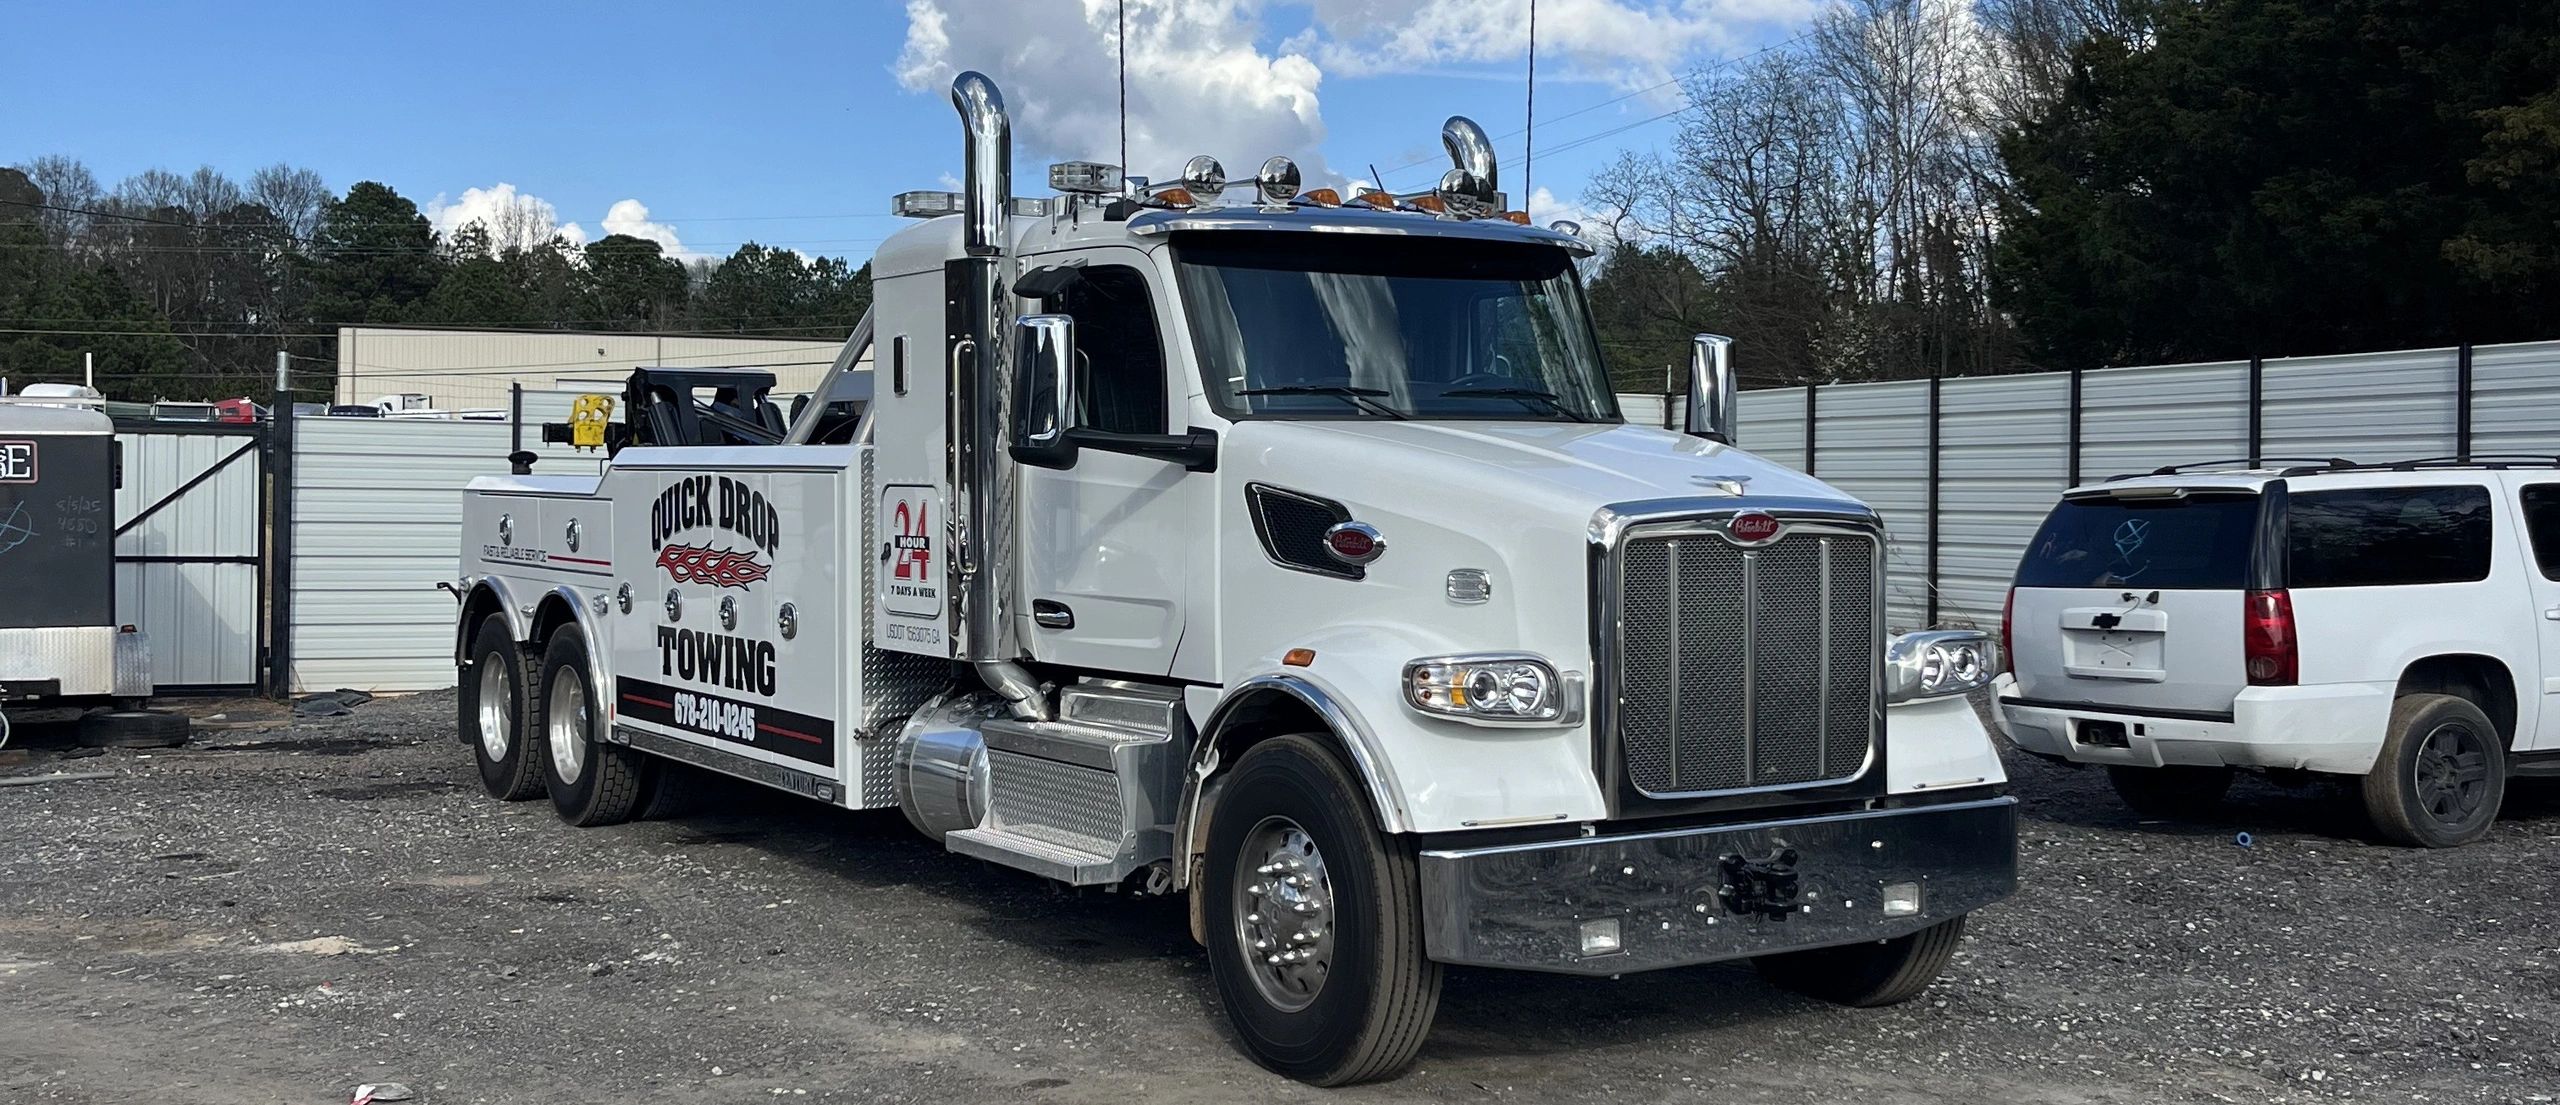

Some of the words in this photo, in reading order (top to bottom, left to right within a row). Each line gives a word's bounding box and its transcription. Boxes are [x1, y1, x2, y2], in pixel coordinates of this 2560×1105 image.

[651, 475, 713, 553] QUICK
[718, 475, 779, 561] DROP
[1735, 518, 1775, 535] Peterbilt
[894, 499, 931, 583] 24
[900, 537, 926, 549] HOUR
[891, 585, 895, 595] 7
[896, 585, 911, 597] DAYS
[913, 587, 918, 597] A
[918, 587, 936, 599] WEEK
[886, 623, 905, 641] USDOT
[657, 624, 776, 697] TOWING
[674, 691, 756, 742] 678-210-0245
